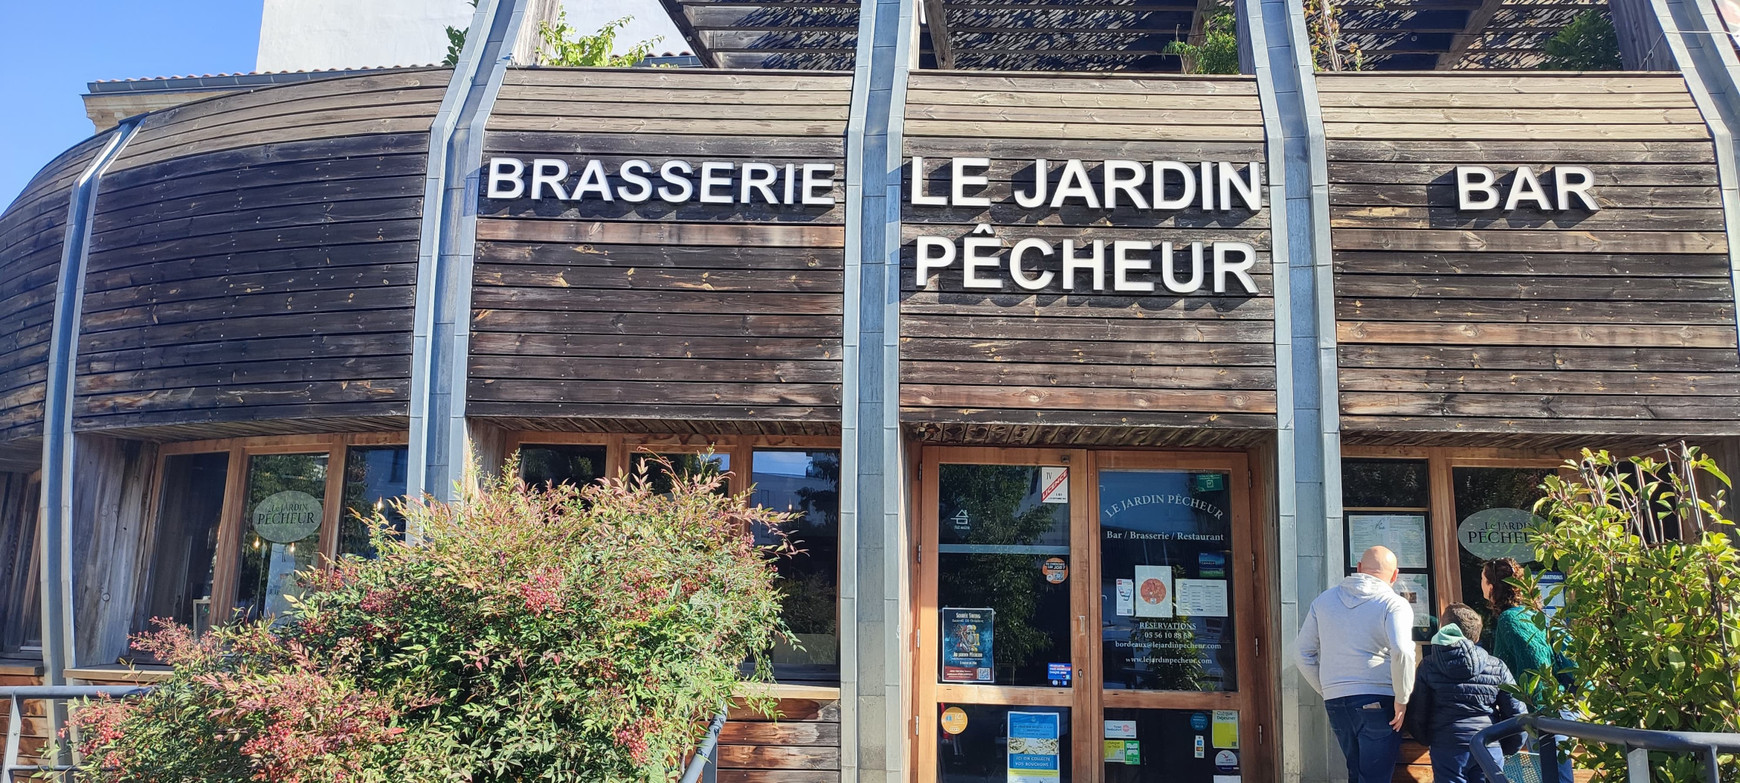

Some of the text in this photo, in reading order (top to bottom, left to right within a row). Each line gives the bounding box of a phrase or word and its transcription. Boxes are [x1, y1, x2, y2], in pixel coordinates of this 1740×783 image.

[486, 157, 836, 206] BRASSERIE
[911, 156, 1262, 212] LE JARDIN
[1456, 166, 1600, 211] BAR
[915, 223, 1260, 294] PÊCHEUR
[1046, 472, 1053, 480] IV
[1042, 469, 1068, 500] LICENCE
[280, 503, 308, 513] JARDIN
[1105, 493, 1224, 520] LE JARDIN PÊCHEUR
[257, 510, 315, 525] PÊCHEUR
[1106, 530, 1122, 539] Bar
[1129, 531, 1170, 541] Brasserie
[1177, 532, 1224, 541] Restaurant
[1139, 621, 1197, 630] RÉSERVATIONS
[1115, 640, 1222, 650] bordeaux@lejardinpecheur.com
[1125, 656, 1213, 665] www.lejardinpecheur.com
